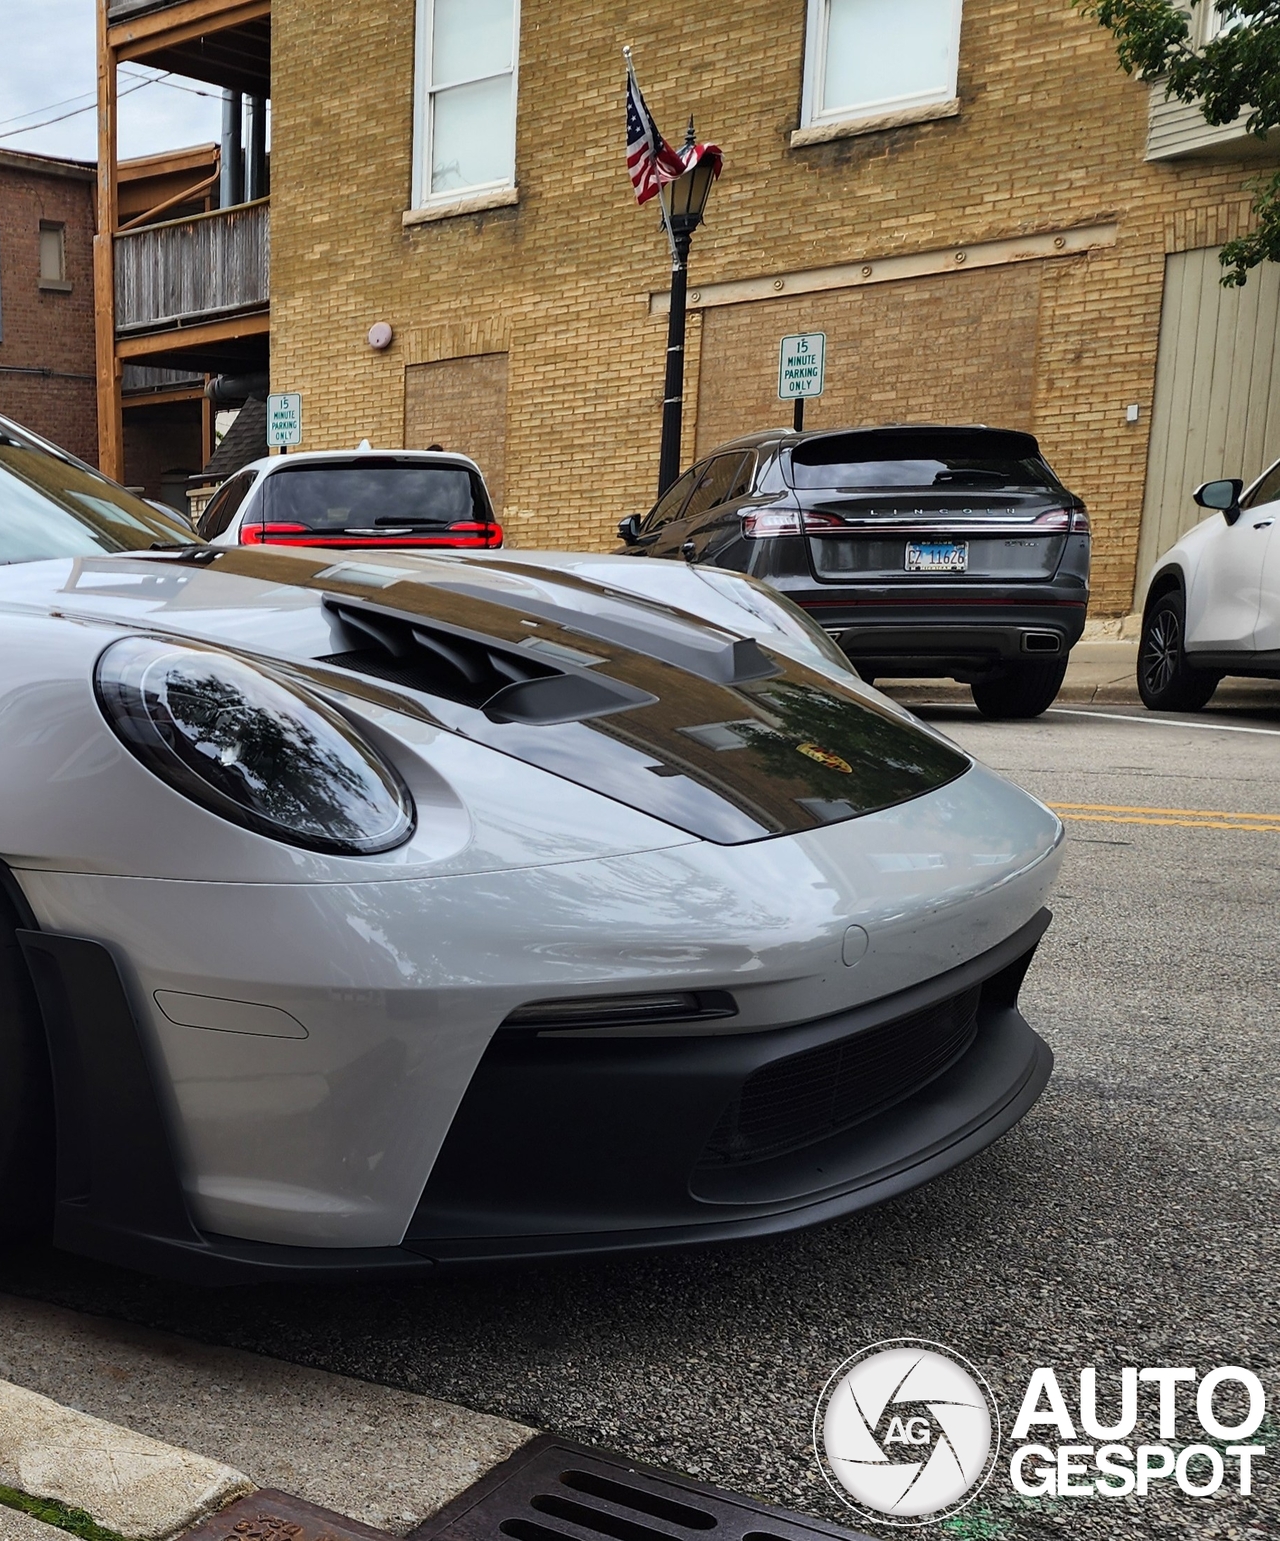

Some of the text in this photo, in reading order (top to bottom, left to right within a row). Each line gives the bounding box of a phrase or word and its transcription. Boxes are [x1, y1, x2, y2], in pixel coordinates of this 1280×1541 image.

[797, 341, 808, 353] 15
[787, 354, 816, 367] MINUTE
[784, 367, 818, 379] PARKING
[789, 380, 812, 391] ONLY
[280, 399, 289, 409] 15
[273, 410, 295, 420] MINUTE
[272, 421, 297, 430] PARKING
[275, 431, 293, 440] ONLY
[870, 507, 1016, 516] LINCOLN
[908, 549, 965, 564] CZ 11626
